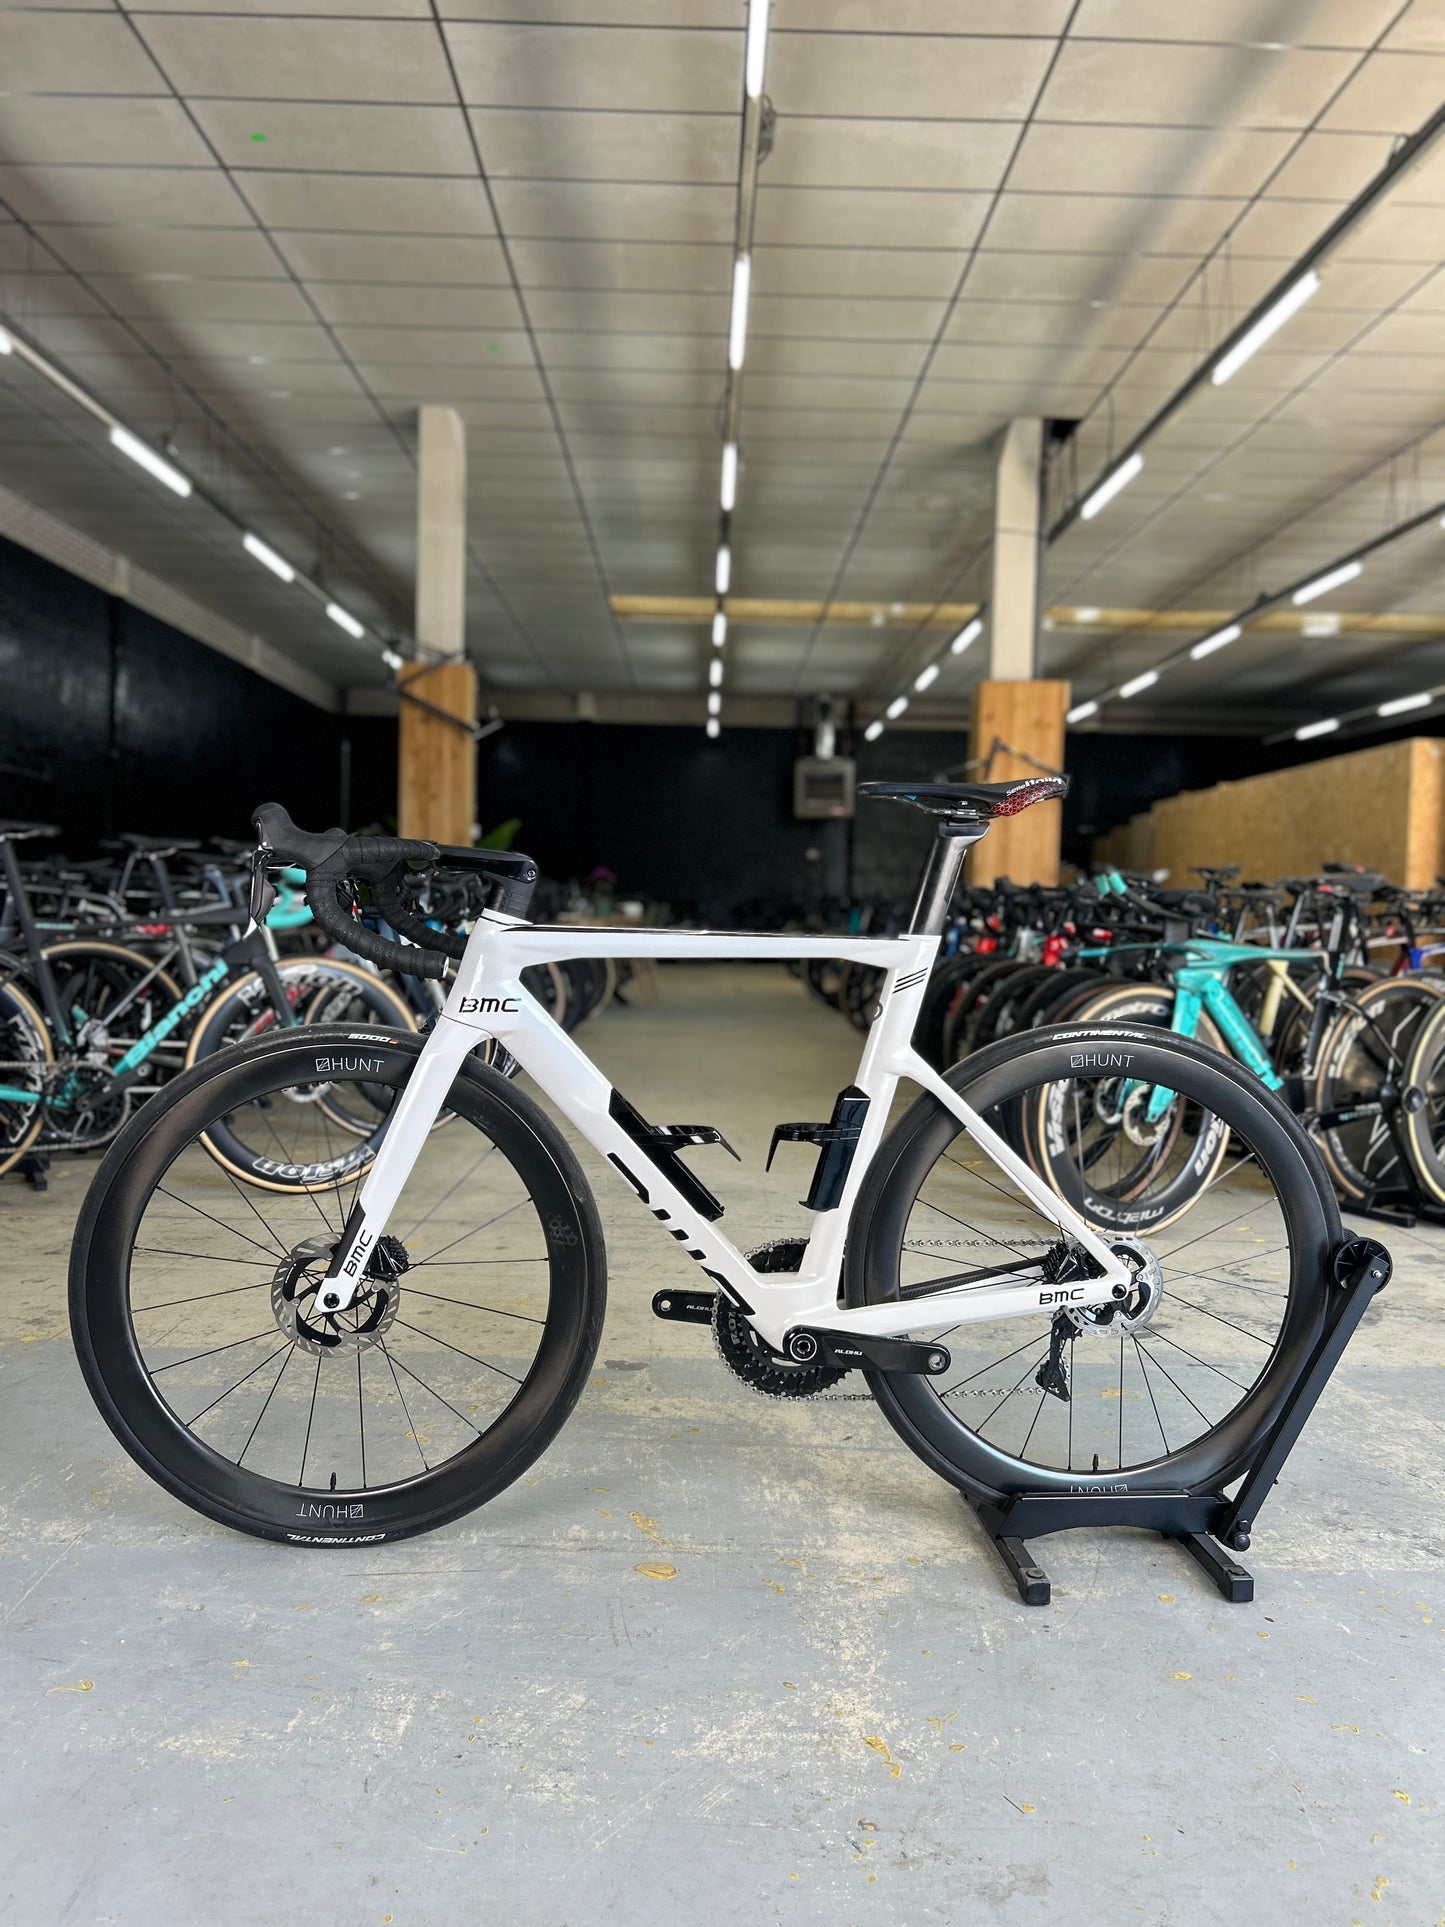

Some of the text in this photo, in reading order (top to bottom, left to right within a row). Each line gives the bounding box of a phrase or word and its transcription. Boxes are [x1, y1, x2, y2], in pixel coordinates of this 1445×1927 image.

[459, 996, 522, 1013] BMC
[1052, 1029, 1148, 1041] CONTINENTAL
[331, 1057, 385, 1073] HUNT
[1085, 1053, 1135, 1068] HUNT
[343, 1229, 373, 1278] BMC
[1039, 1287, 1085, 1305] BMC
[295, 1503, 348, 1519] HUNT
[287, 1533, 386, 1544] CONTINENTAL
